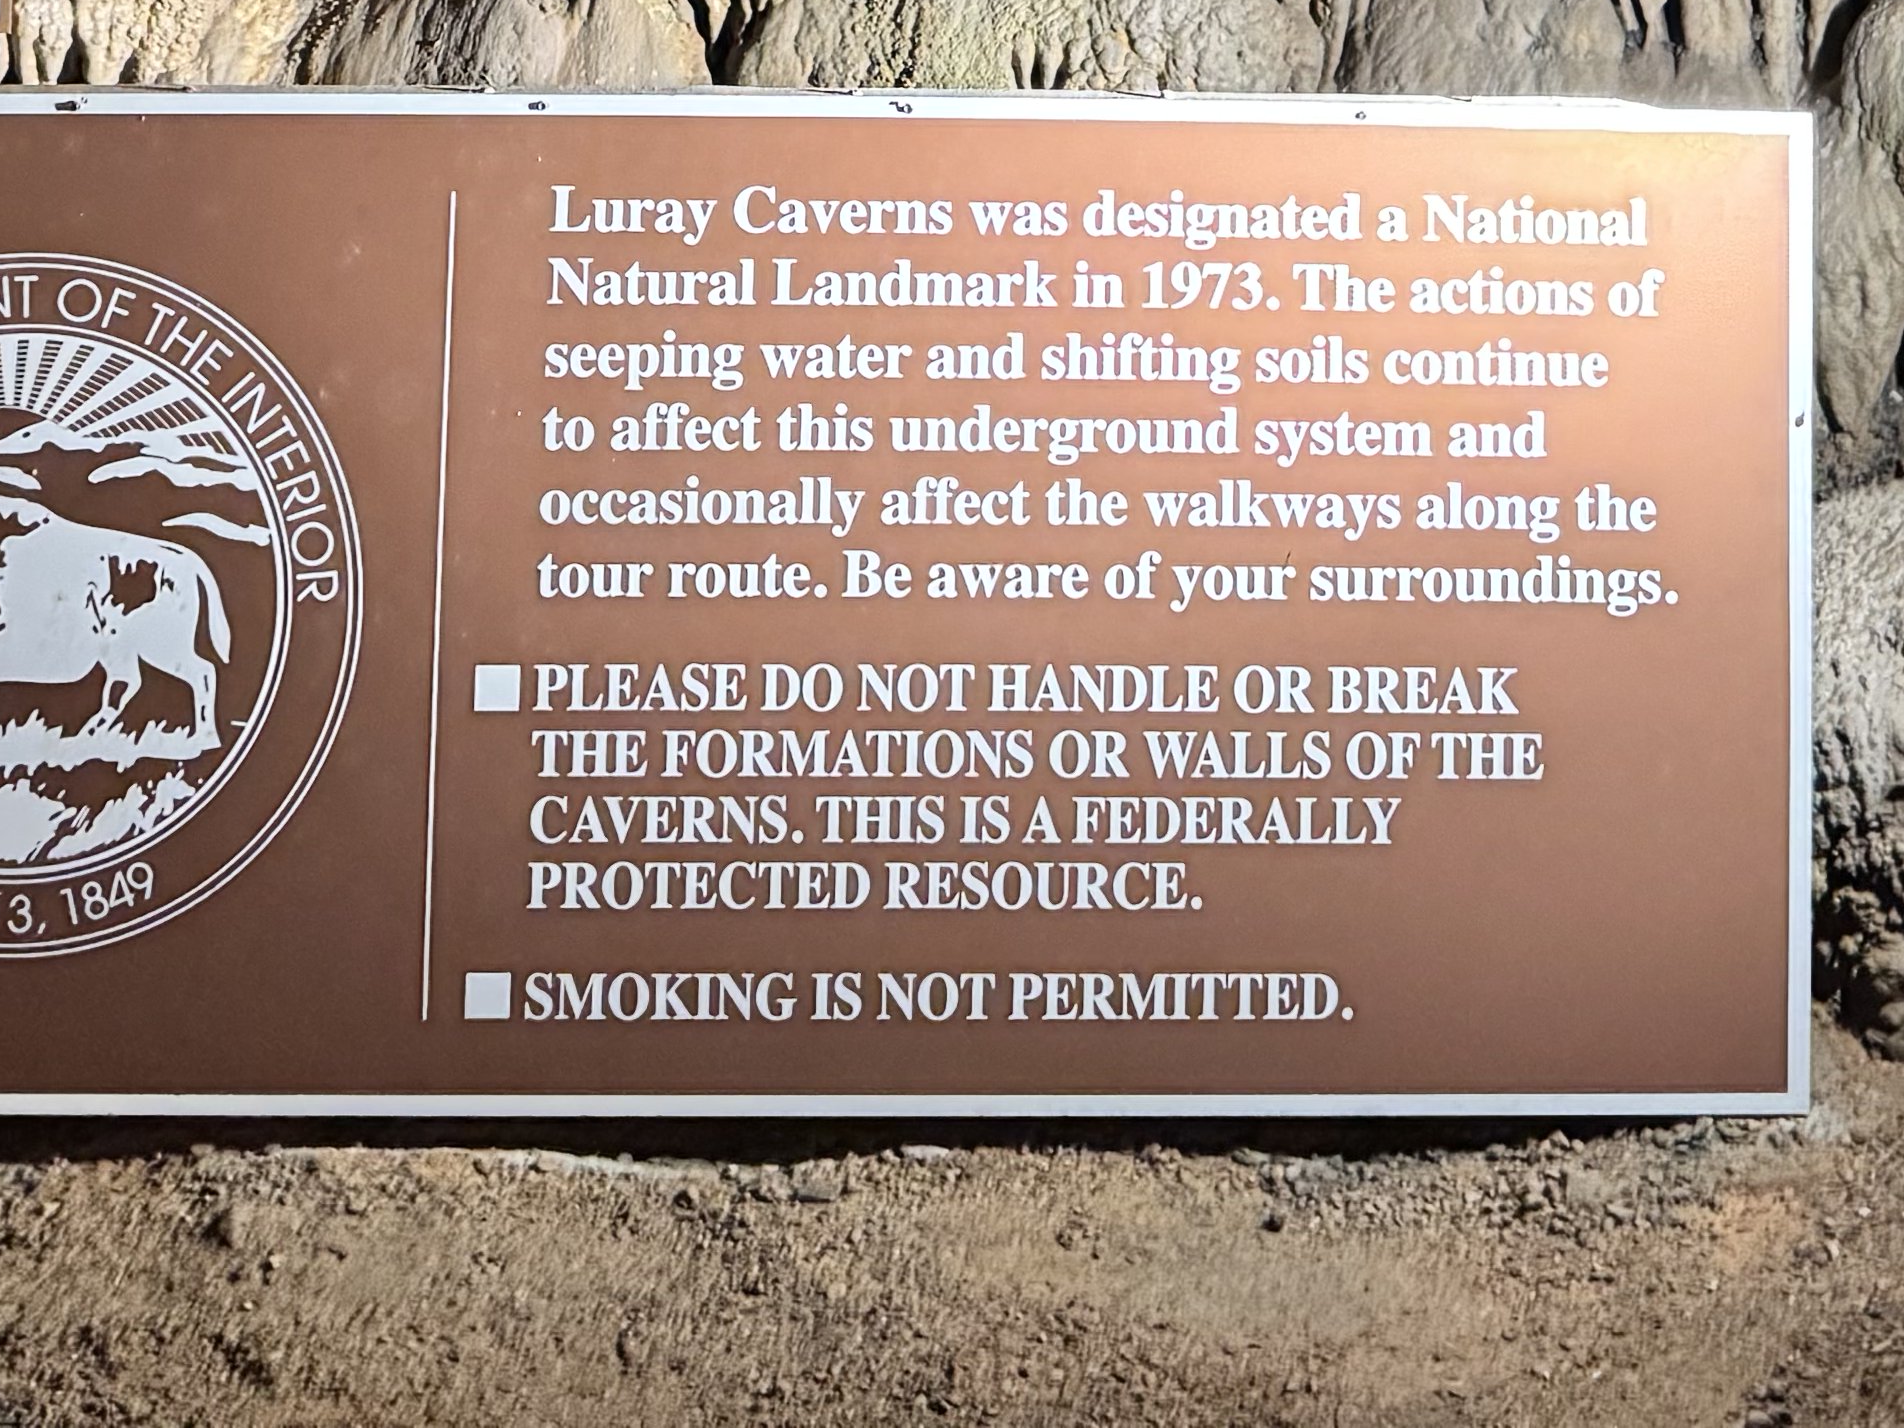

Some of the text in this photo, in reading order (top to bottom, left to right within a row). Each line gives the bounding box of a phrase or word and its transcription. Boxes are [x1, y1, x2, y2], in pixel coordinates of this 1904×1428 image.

[548, 185, 1648, 251] Luray Caverns was designated a National
[546, 257, 1665, 317] Natural Landmark in 1973. The actions of
[544, 329, 1609, 395] seeping water and shifting soils continue
[56, 278, 137, 329] OF
[150, 301, 235, 386] THE
[221, 371, 339, 603] INTERIOR
[541, 402, 1548, 468] to affect this underground system and
[539, 475, 1657, 544] occasionally affect the walkways along the
[536, 549, 1679, 617] tour route. Be aware of your surroundings.
[532, 662, 1520, 715] PLEASE DO NOT HANDLE OR BREAK
[531, 729, 1545, 781] THE FORMATIONS OR WALLS OF THE
[529, 794, 1402, 845] CAVERNS. THIS IS A FEDERALLY
[7, 893, 47, 935] 3,
[59, 861, 154, 925] 1849
[525, 860, 1203, 911] PROTECTED RESOURCE.
[524, 971, 1354, 1022] SMOKING IS NOT PERMITTED.
